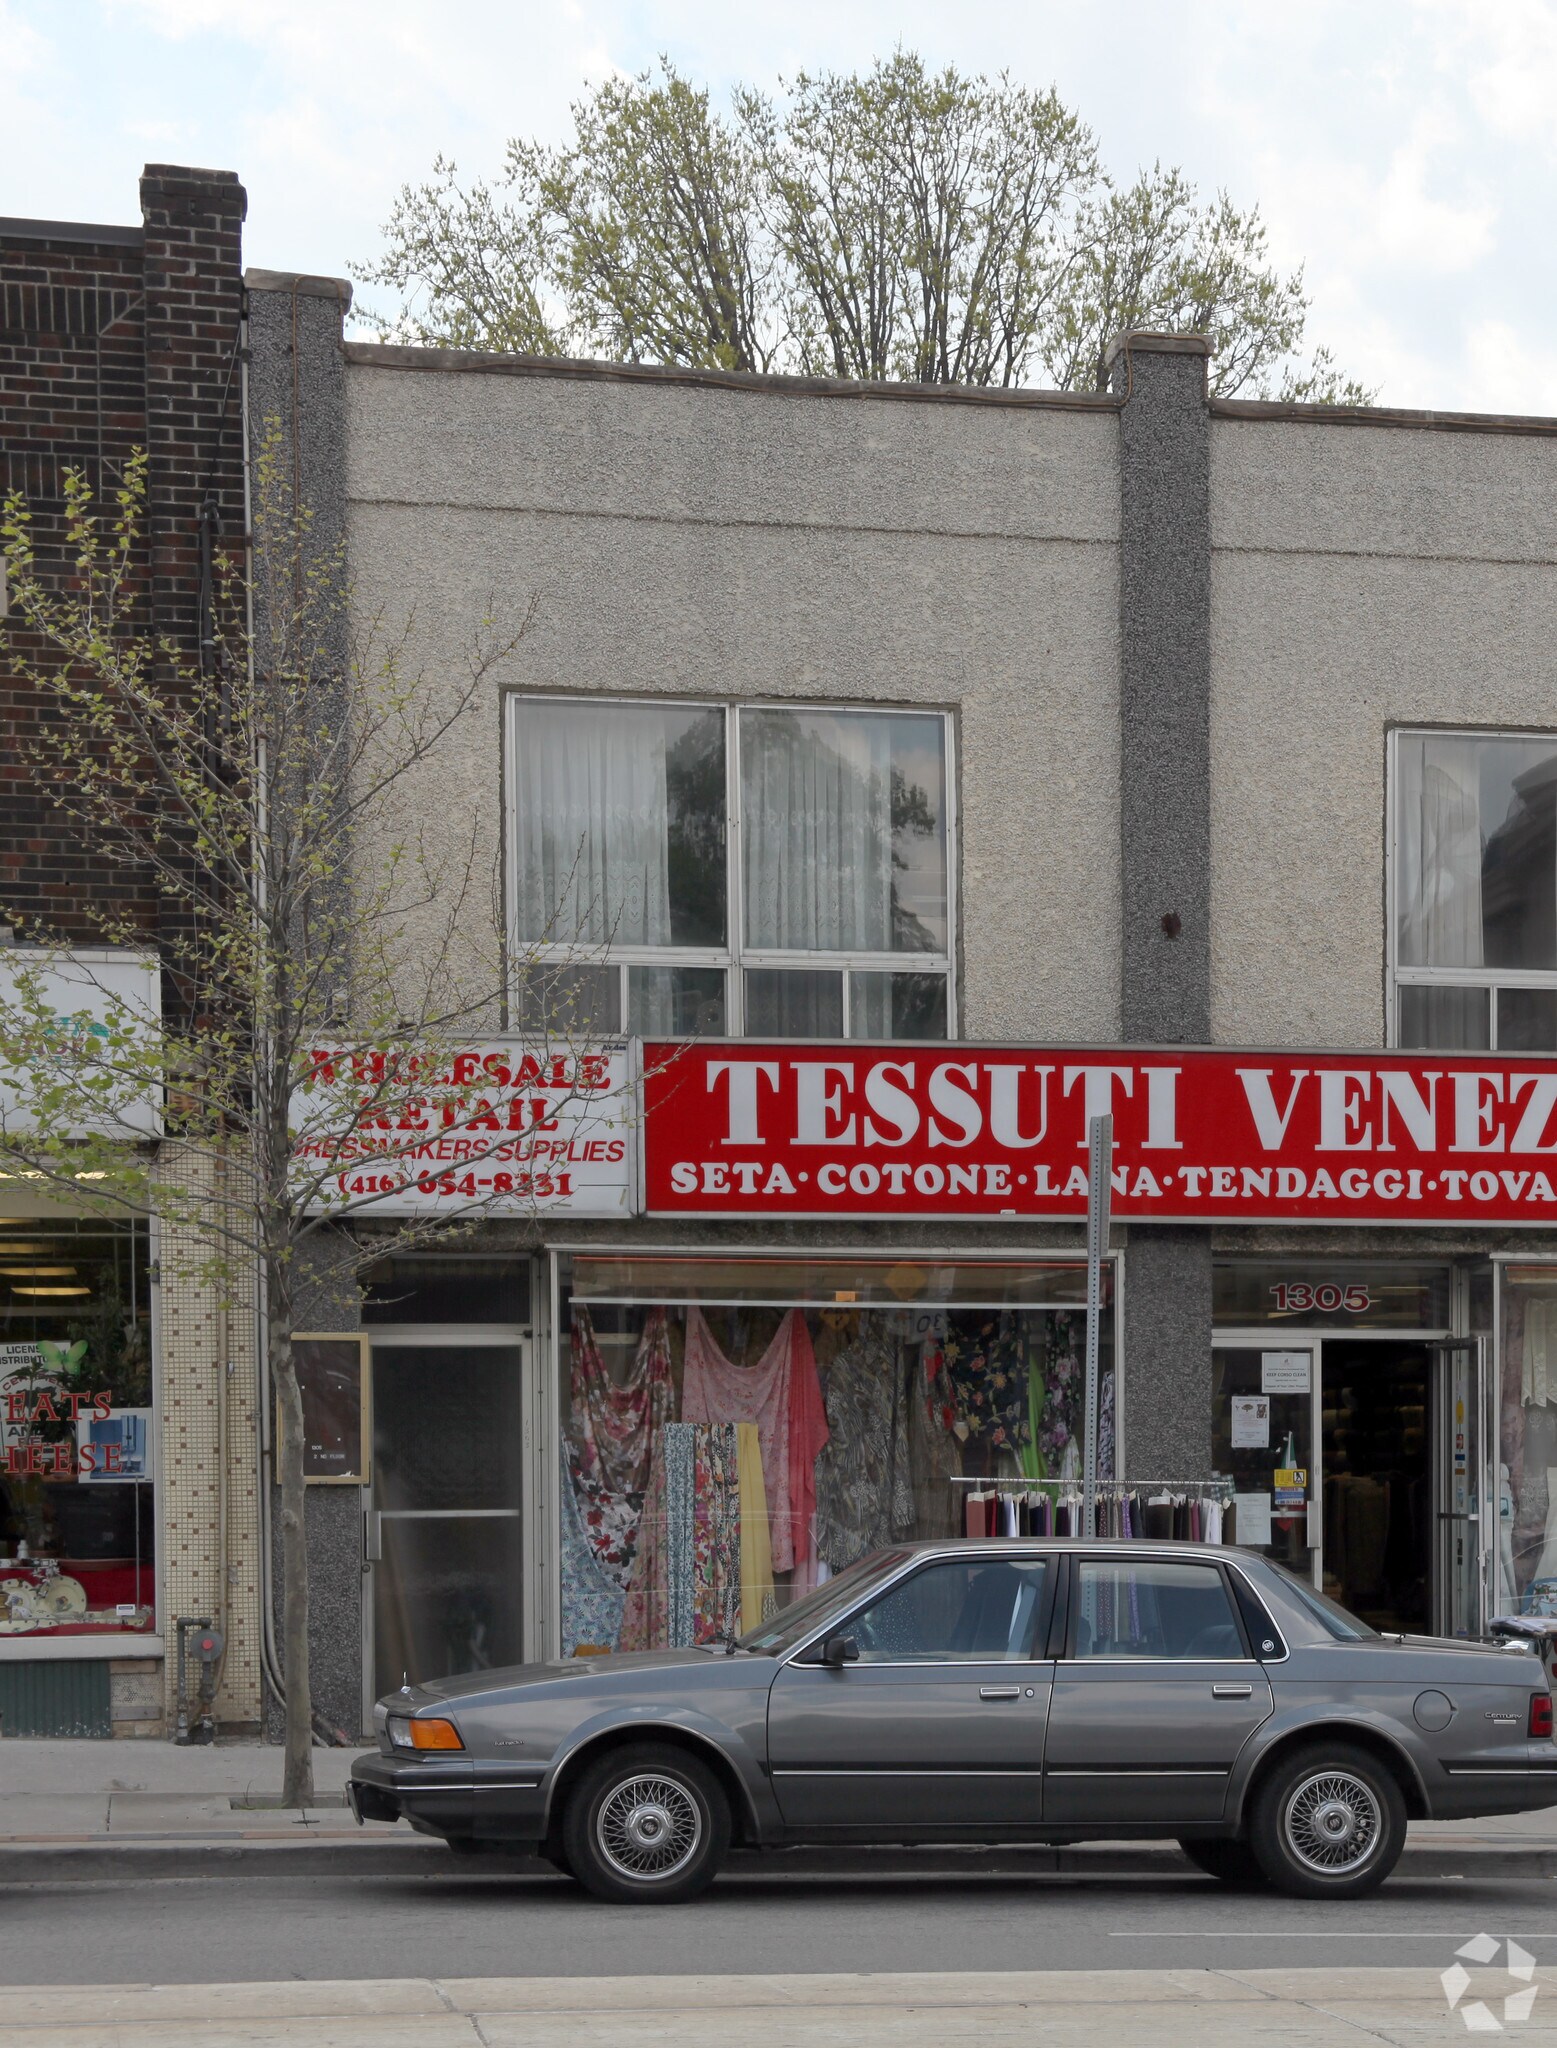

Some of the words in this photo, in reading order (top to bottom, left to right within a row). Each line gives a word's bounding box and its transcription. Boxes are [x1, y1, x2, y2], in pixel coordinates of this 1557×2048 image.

[357, 1096, 559, 1132] RETAIL
[707, 1061, 1183, 1149] TESSUTI
[1236, 1069, 1557, 1154] VENEZ
[497, 1140, 625, 1163] SUPPLIES
[1270, 1283, 1371, 1312] 1305
